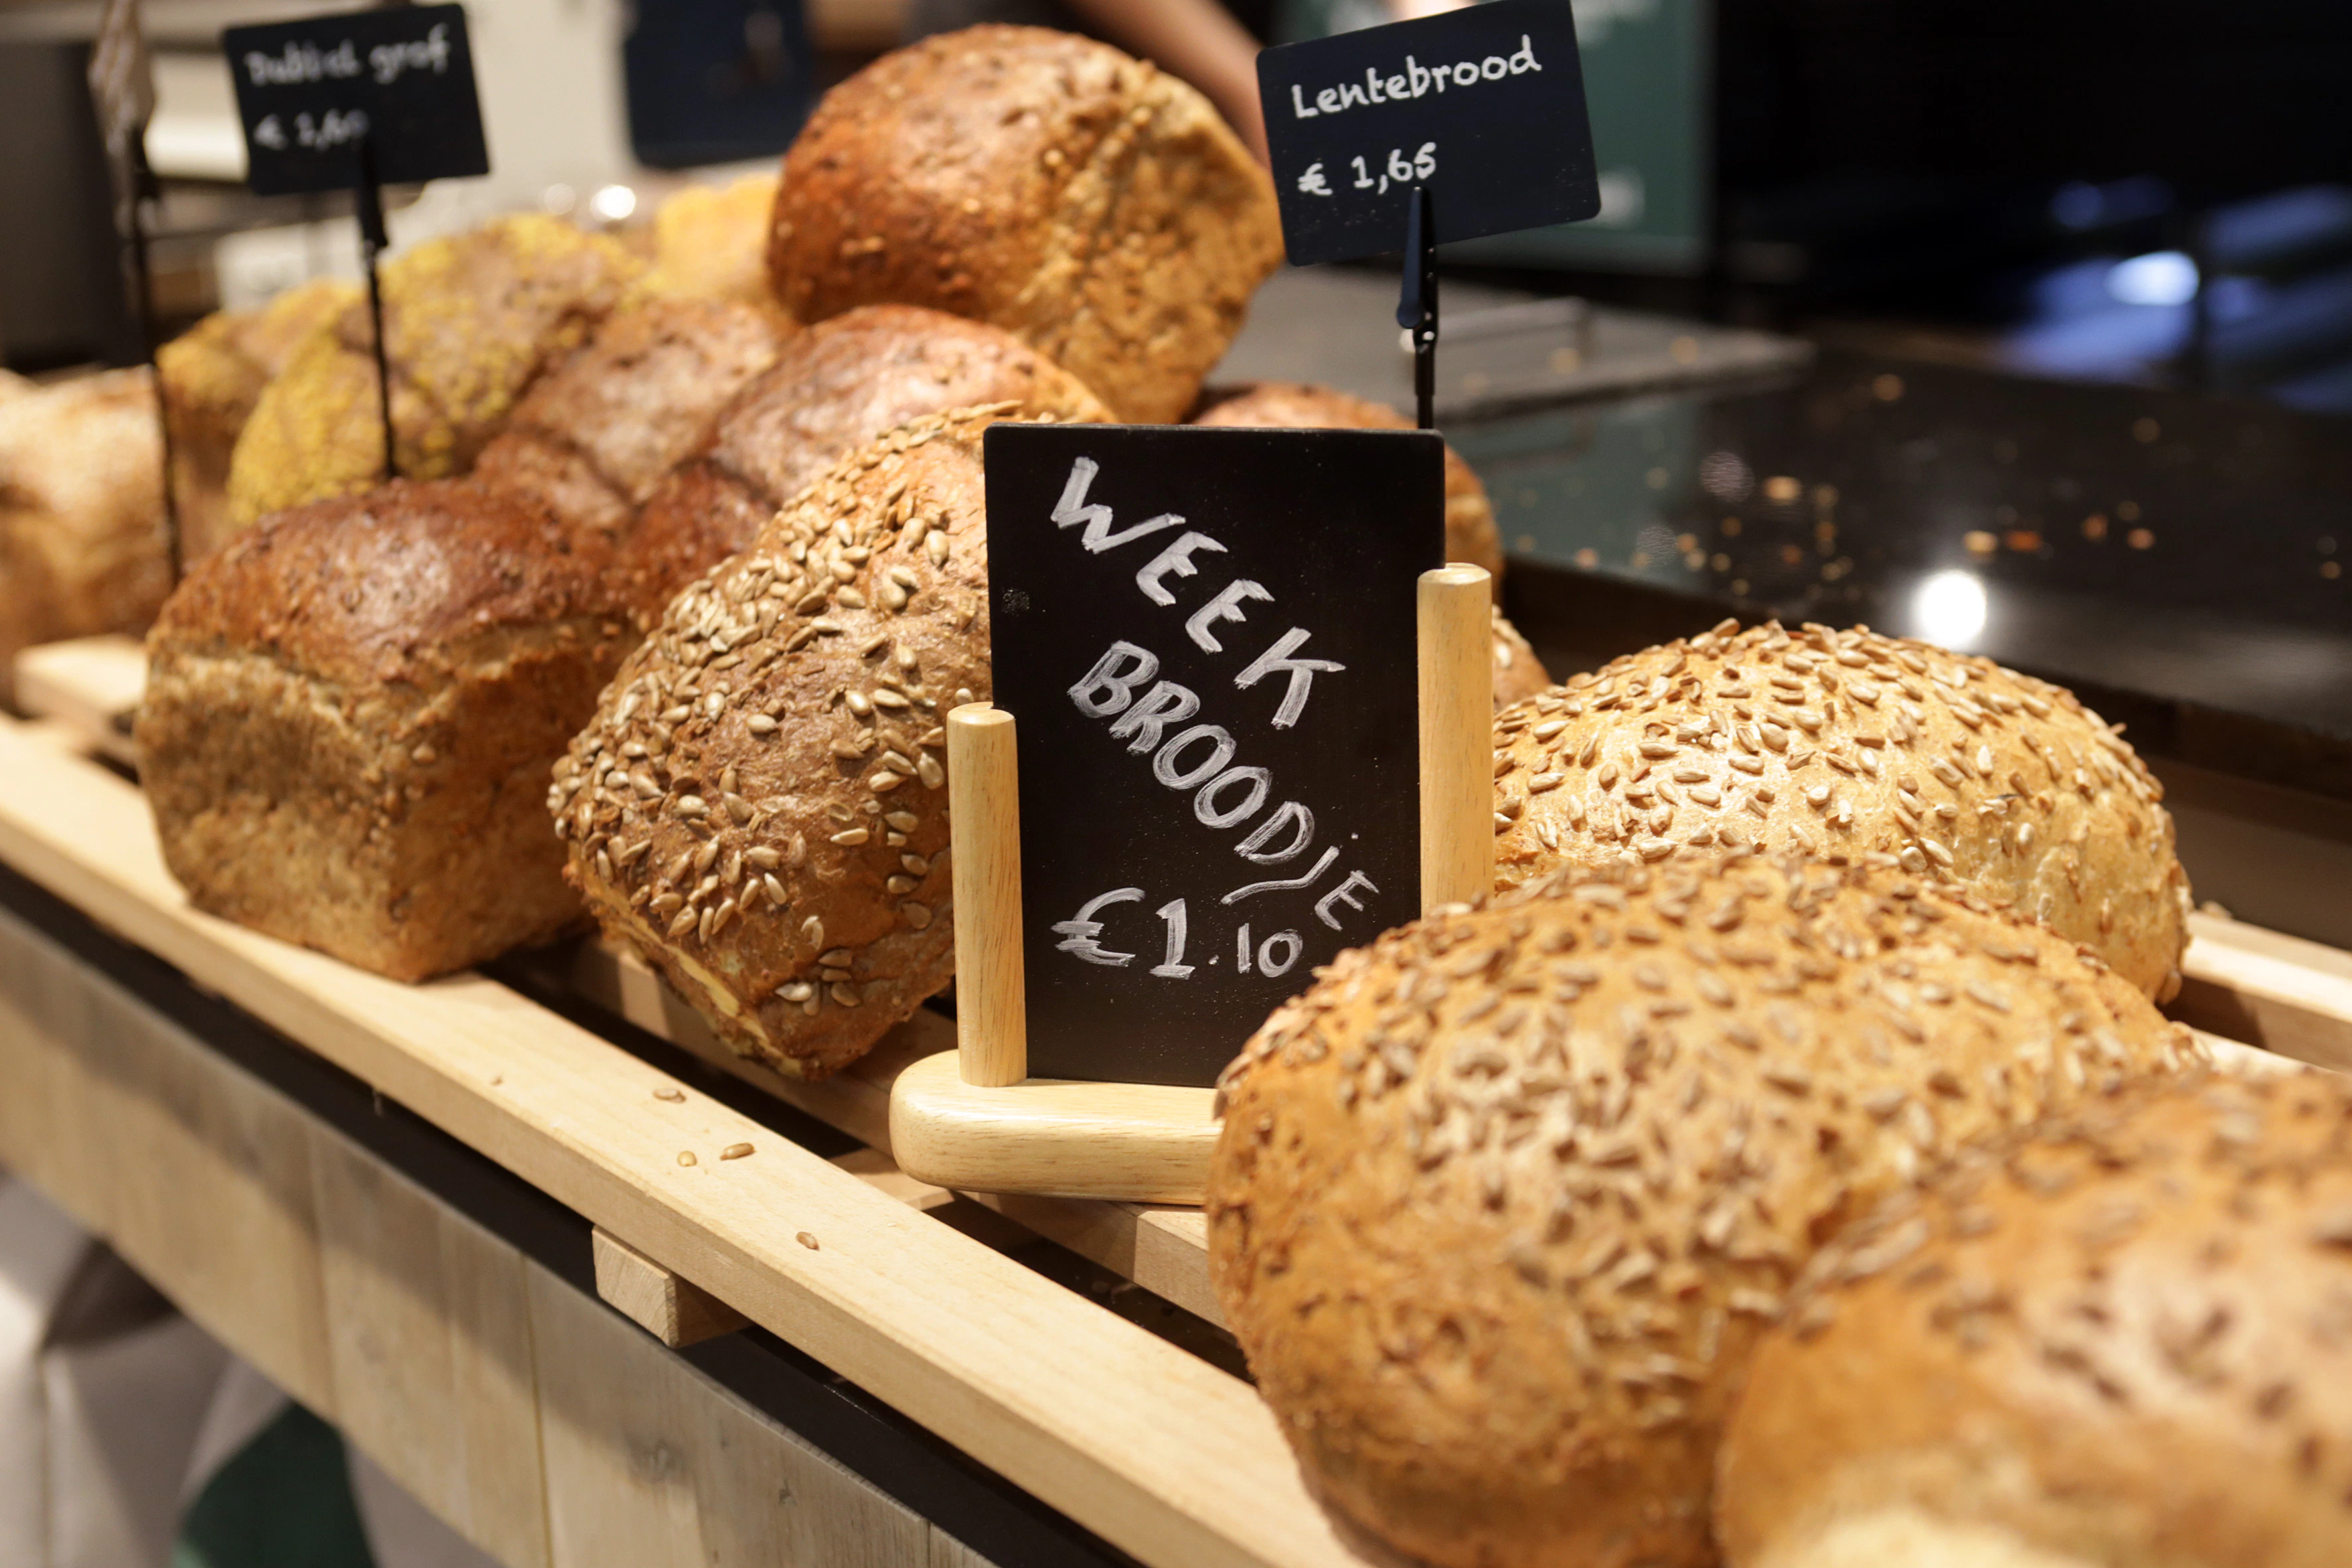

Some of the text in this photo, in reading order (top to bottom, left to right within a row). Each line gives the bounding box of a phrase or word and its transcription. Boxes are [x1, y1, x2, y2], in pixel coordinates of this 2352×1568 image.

[1292, 35, 1541, 119] Lentebrood
[1298, 142, 1437, 195] € 1,65
[1051, 456, 1346, 730] WEEK
